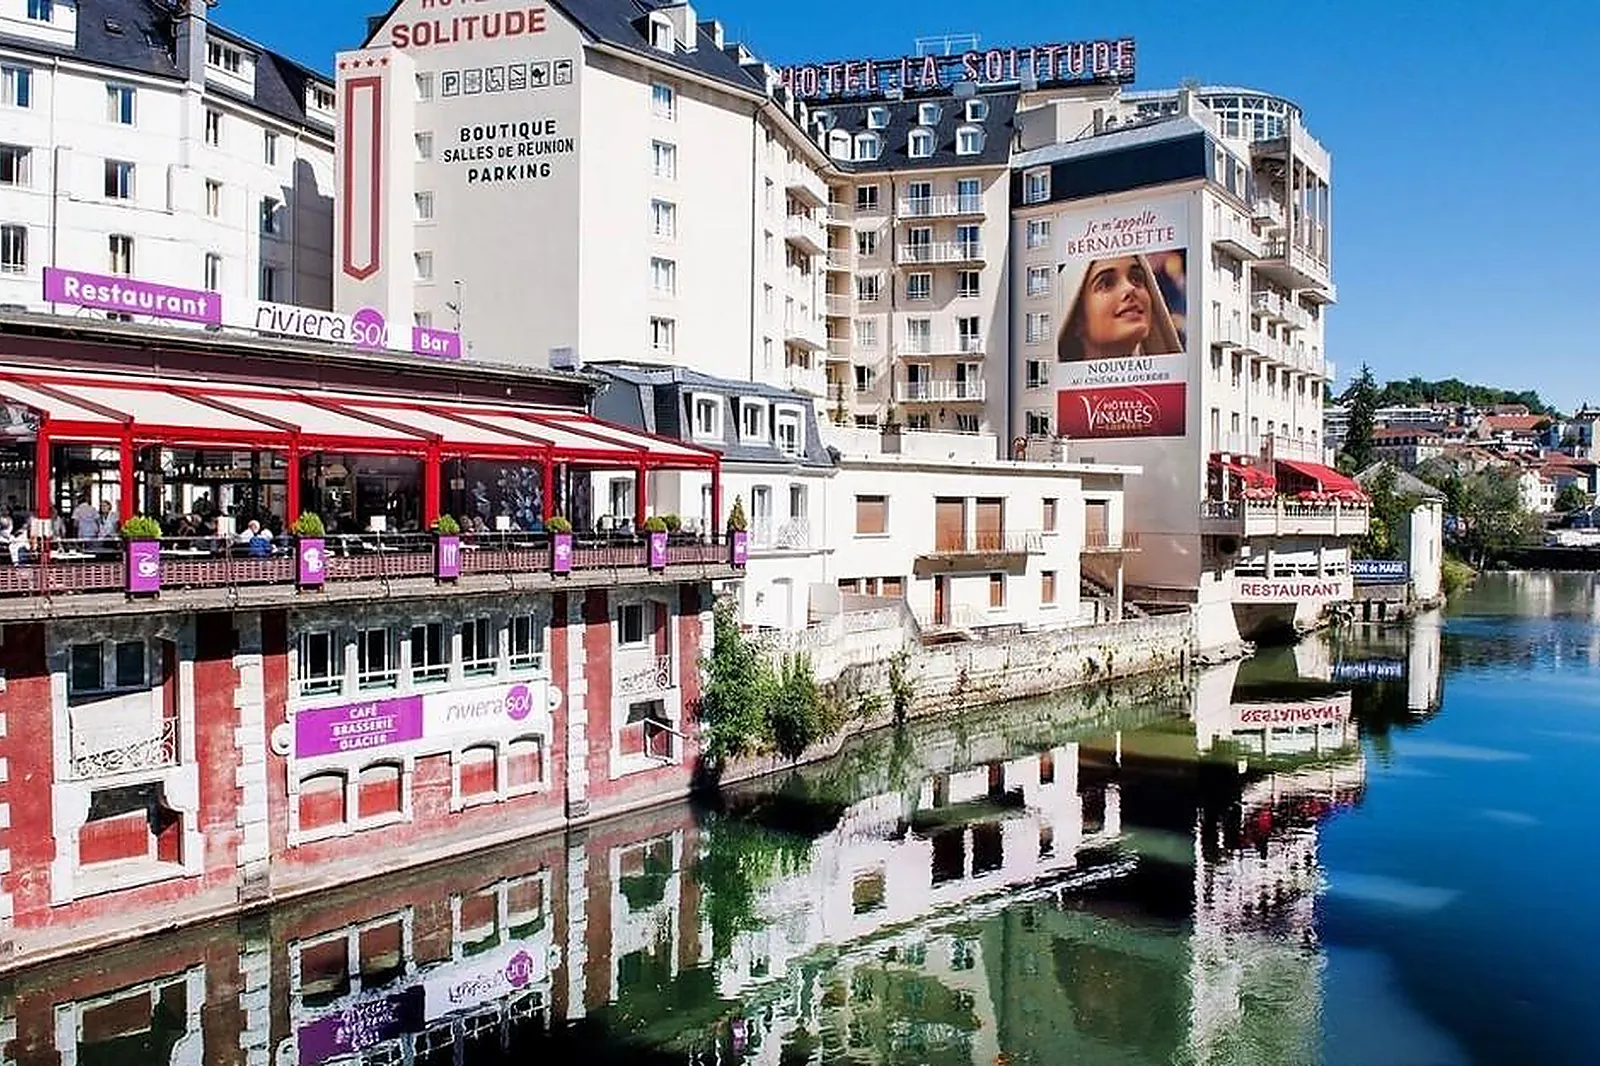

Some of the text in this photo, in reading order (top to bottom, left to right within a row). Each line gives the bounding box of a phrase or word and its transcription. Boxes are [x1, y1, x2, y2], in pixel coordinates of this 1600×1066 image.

[391, 8, 546, 48] SOLITUDE
[901, 54, 942, 89] LA
[962, 40, 1135, 83] SOLITUDE
[460, 120, 556, 142] BOUTIQUE
[443, 145, 494, 163] SALLES
[517, 138, 574, 156] REUNION
[468, 162, 551, 183] PARKING
[1085, 221, 1098, 238] Je
[1067, 226, 1175, 255] BERNADETTE
[63, 276, 207, 316] Restaurant
[255, 304, 345, 339] riviera
[420, 332, 450, 352] Bar
[1088, 358, 1153, 375] NOUVEAU
[1240, 582, 1343, 597] RESTAURANT
[349, 702, 378, 719] CAFÉ
[446, 698, 503, 721] riviera
[332, 716, 394, 737] BRASSERIE
[339, 734, 388, 751] GLACIER
